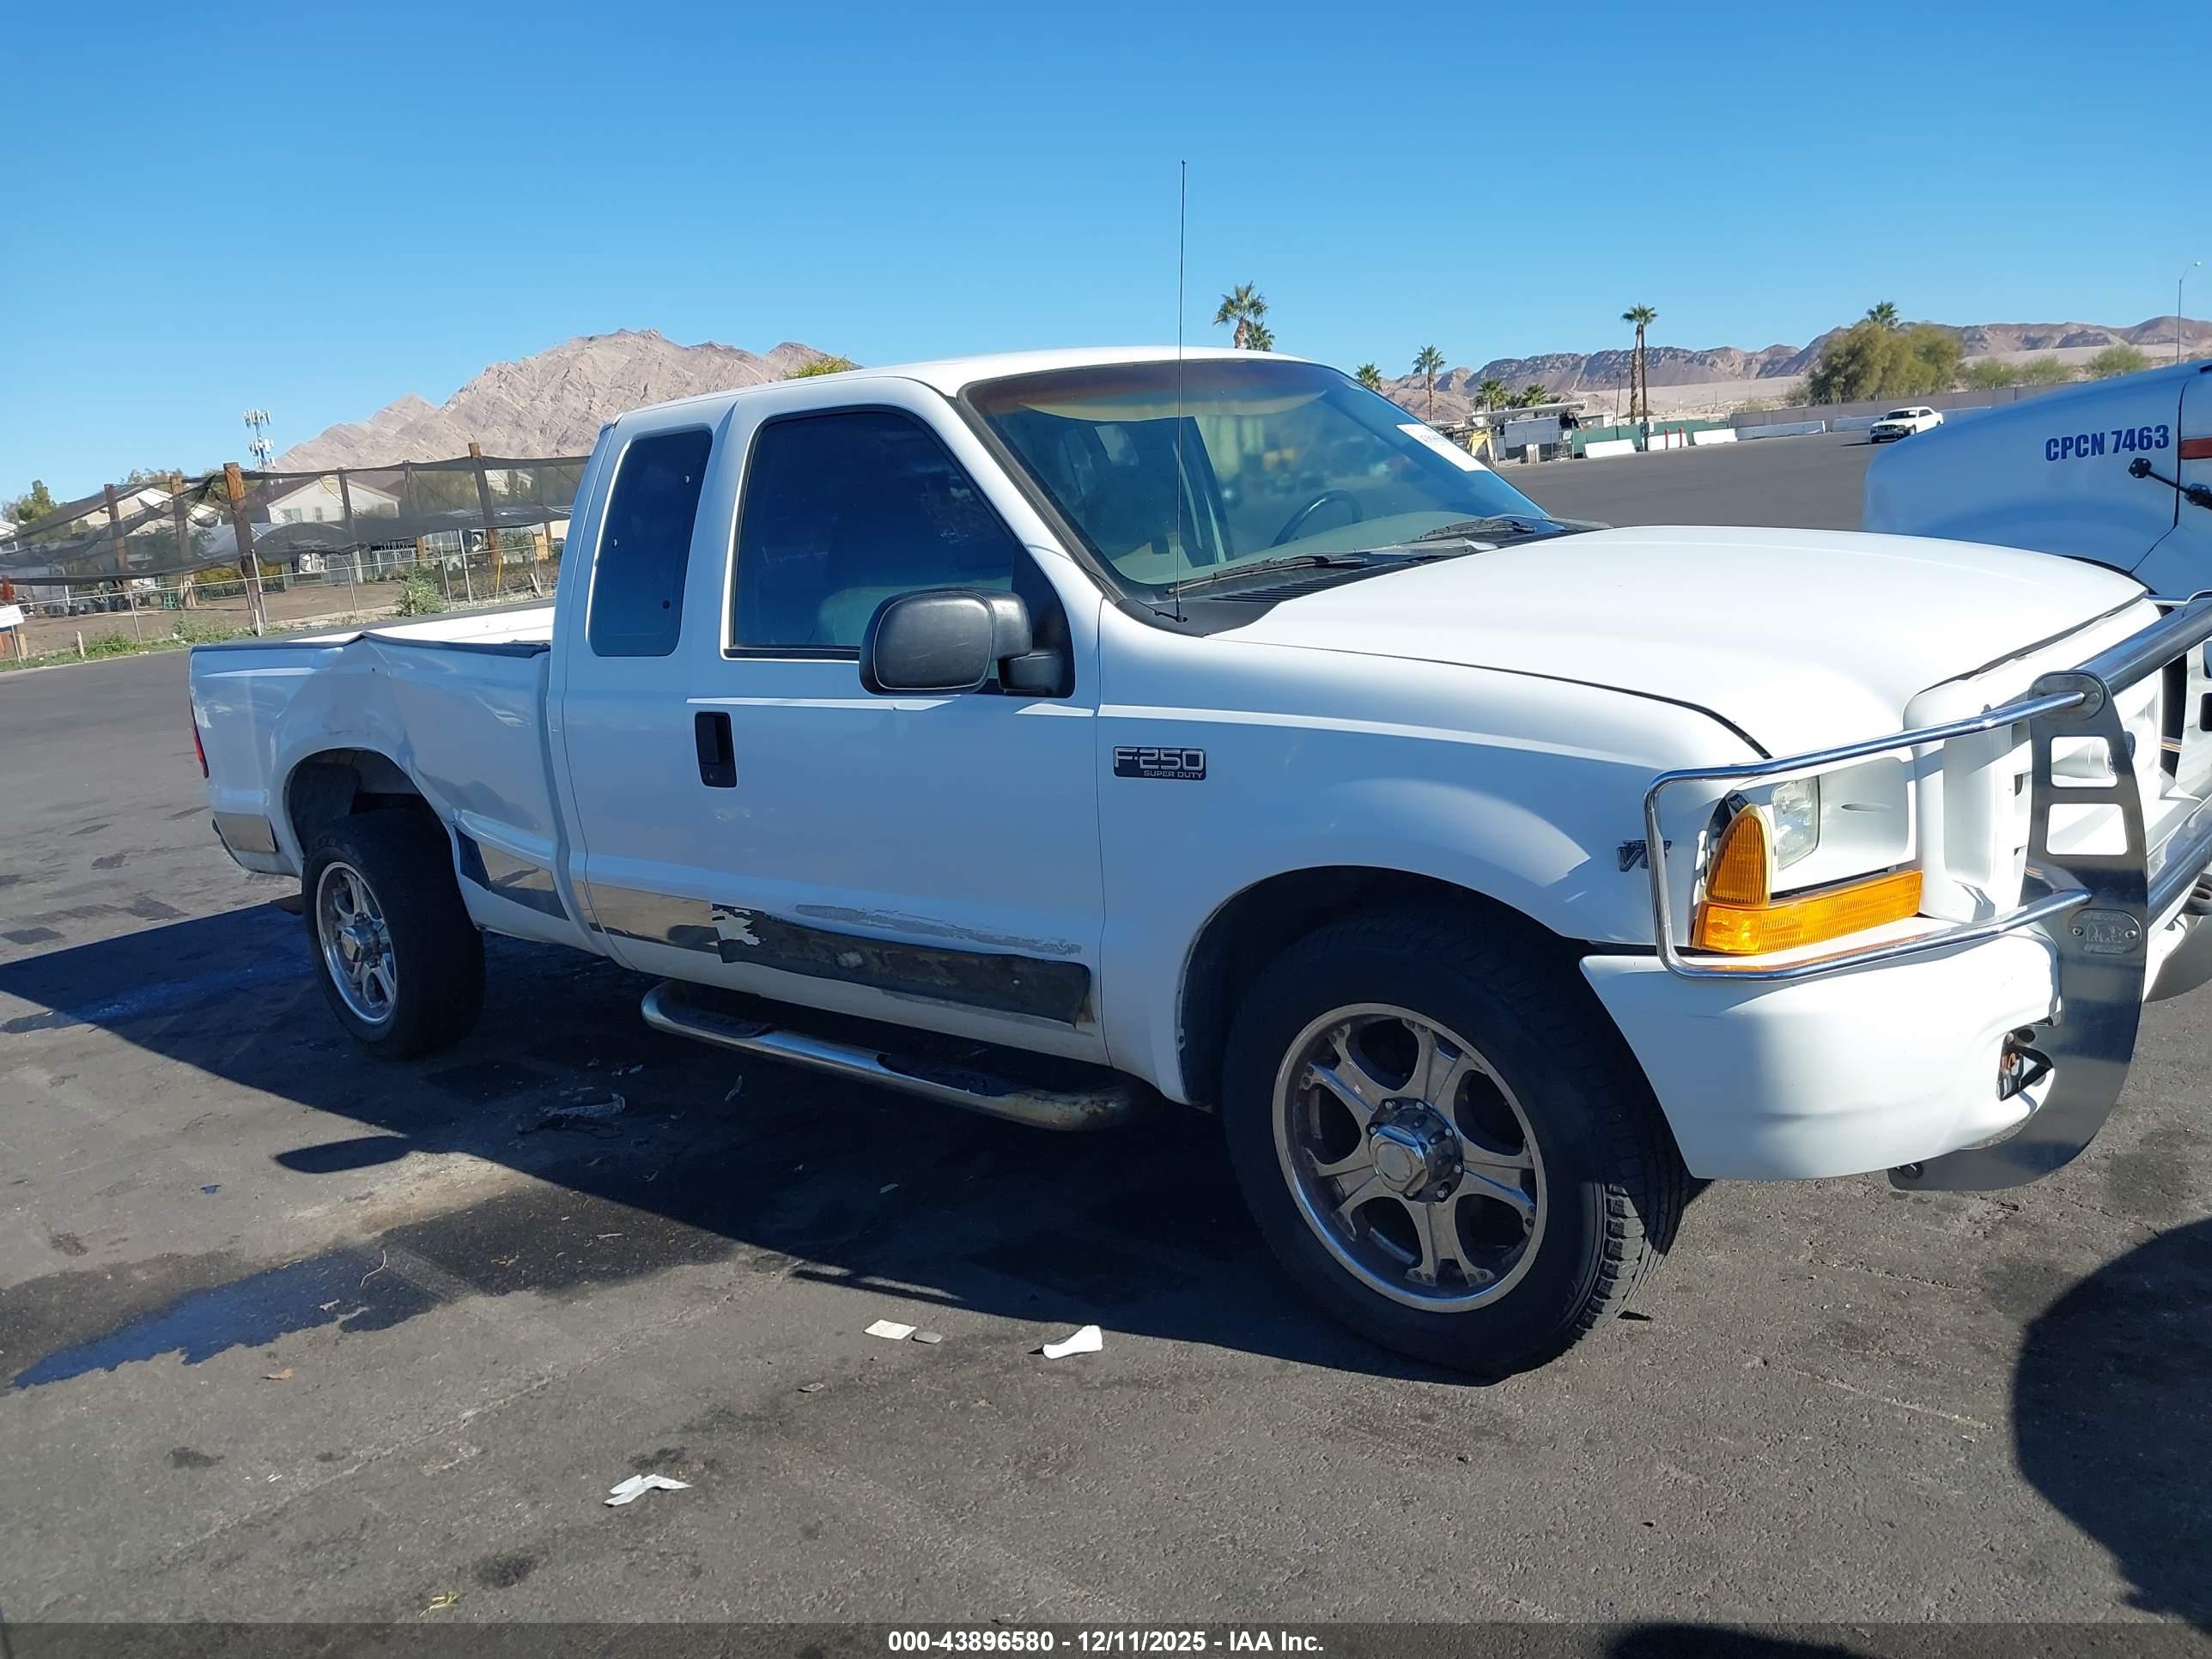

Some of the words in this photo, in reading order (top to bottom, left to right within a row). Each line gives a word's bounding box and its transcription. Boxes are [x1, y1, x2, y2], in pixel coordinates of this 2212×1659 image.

[2045, 432, 2105, 461] CPCN
[2111, 424, 2170, 454] 7463
[1115, 748, 1204, 770] F-250
